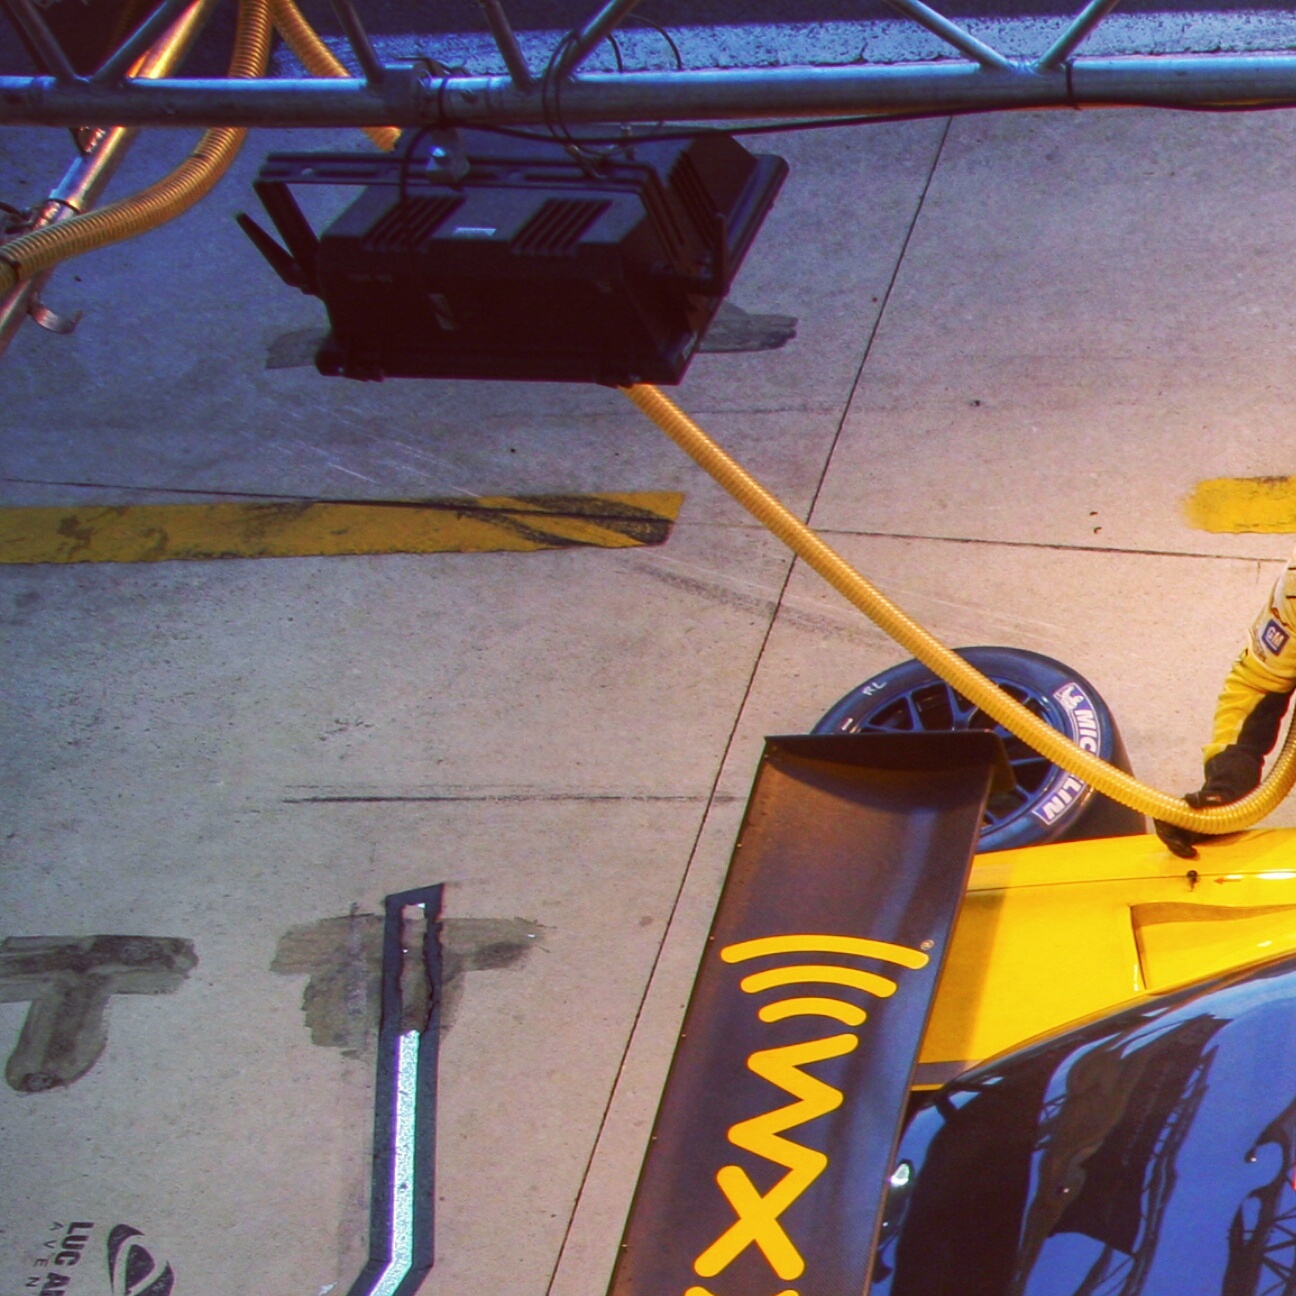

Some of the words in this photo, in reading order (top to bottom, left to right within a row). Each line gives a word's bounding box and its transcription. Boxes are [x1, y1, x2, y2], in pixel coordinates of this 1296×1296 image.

[1265, 624, 1285, 648] GM
[1043, 709, 1099, 821] MICLIN
[694, 1033, 859, 1281] XM
[53, 1221, 95, 1267] LUC
